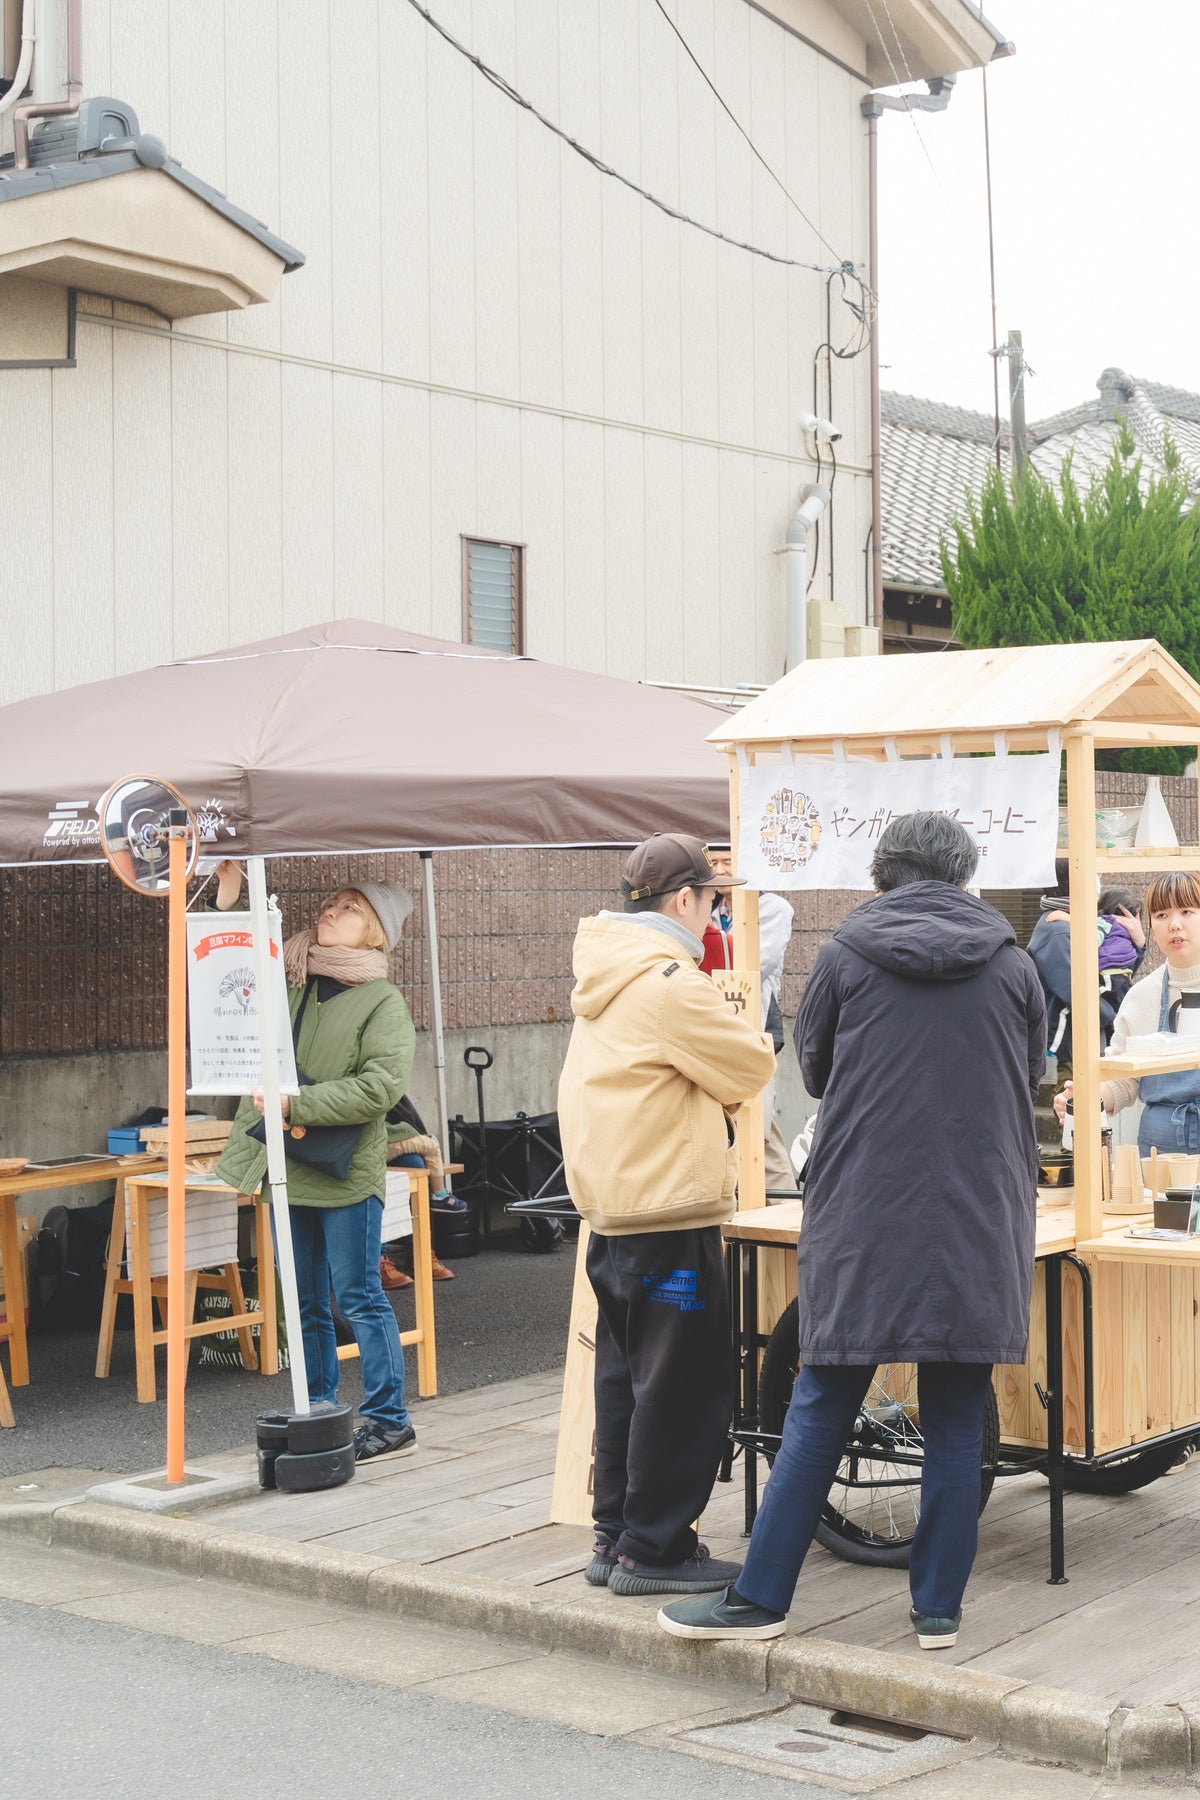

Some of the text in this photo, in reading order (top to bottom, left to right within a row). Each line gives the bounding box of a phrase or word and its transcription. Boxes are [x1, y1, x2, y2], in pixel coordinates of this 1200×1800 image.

[61, 819, 101, 836] FIELD
[830, 806, 1037, 838] ゼンガーコーヒー
